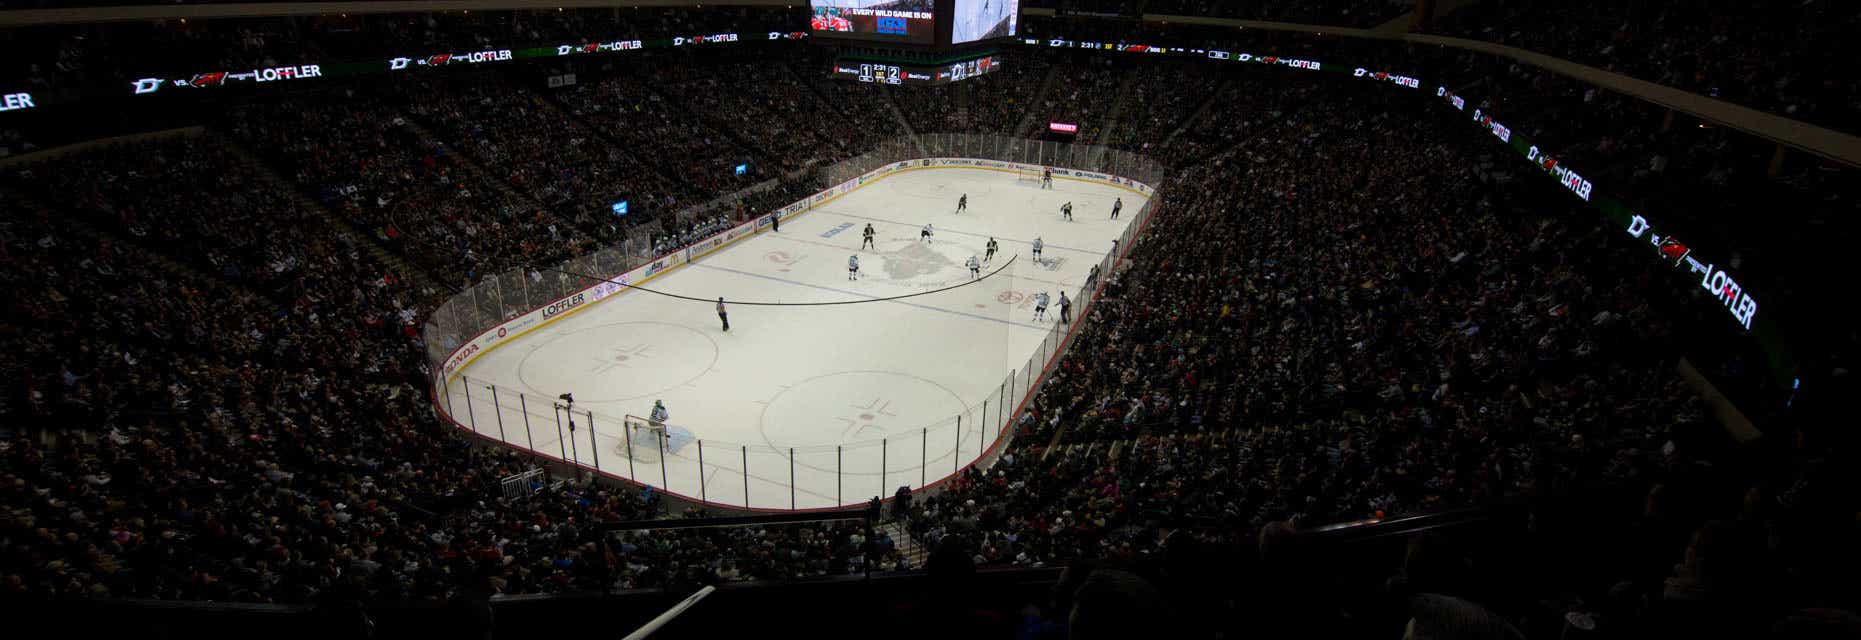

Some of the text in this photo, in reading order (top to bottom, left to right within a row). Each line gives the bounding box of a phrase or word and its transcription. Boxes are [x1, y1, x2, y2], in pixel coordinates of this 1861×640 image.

[852, 8, 875, 16] EVERY
[712, 33, 738, 43] LOFFLER
[610, 40, 642, 51] LOFFLER
[468, 50, 513, 63] LOFFLER
[1288, 58, 1321, 71] LOFFLER
[253, 64, 322, 82] LOFFLER
[1395, 75, 1420, 89] LOFFLER
[1560, 167, 1592, 202] LOFFLER
[1701, 264, 1757, 330] LOFFLER
[542, 293, 585, 317] LOFFLER
